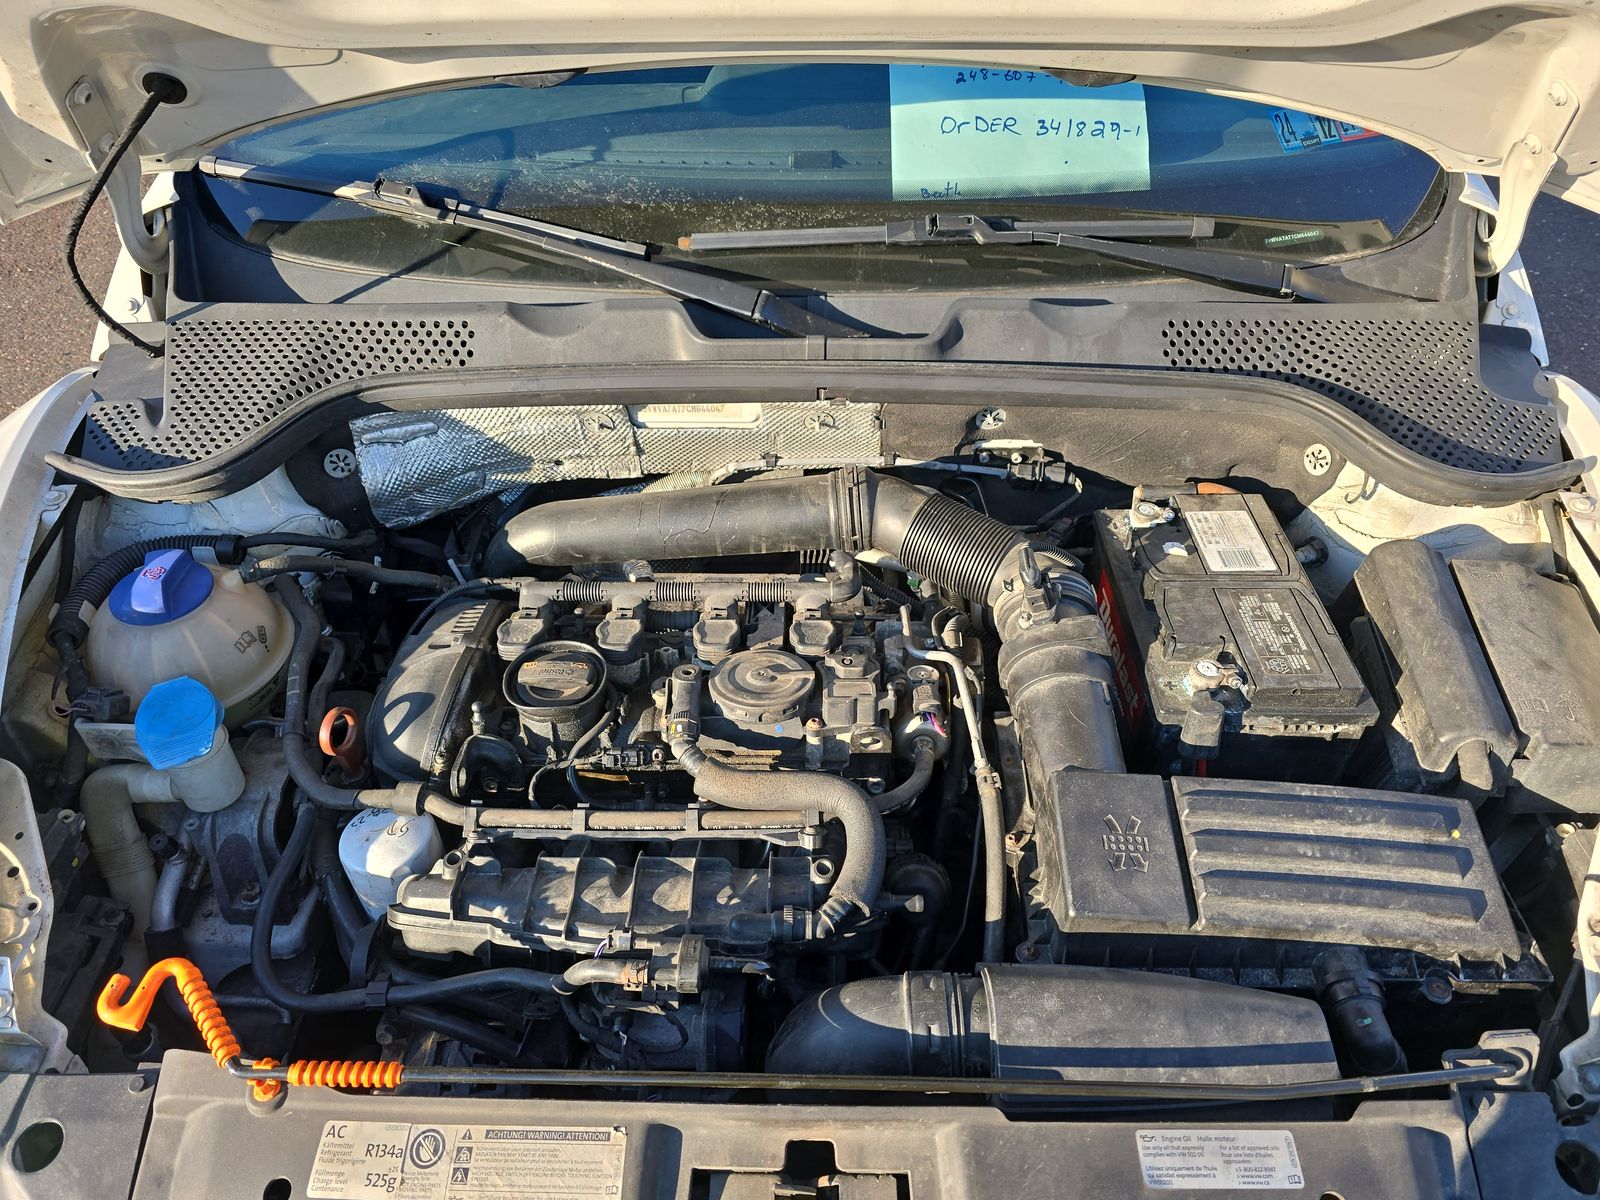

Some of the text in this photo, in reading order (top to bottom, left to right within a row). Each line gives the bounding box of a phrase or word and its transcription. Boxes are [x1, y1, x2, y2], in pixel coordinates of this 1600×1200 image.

[1274, 112, 1298, 143] 24
[1099, 586, 1139, 718] Duralast
[325, 1125, 348, 1138] AC
[487, 1130, 609, 1141] ACHTUNG! WARNING! ATTENTION!
[1161, 1135, 1182, 1143] Engine
[320, 1149, 353, 1157] Refrigerant
[365, 1143, 404, 1159] R134a
[312, 1177, 333, 1185] Charge
[364, 1173, 397, 1193] 525g
